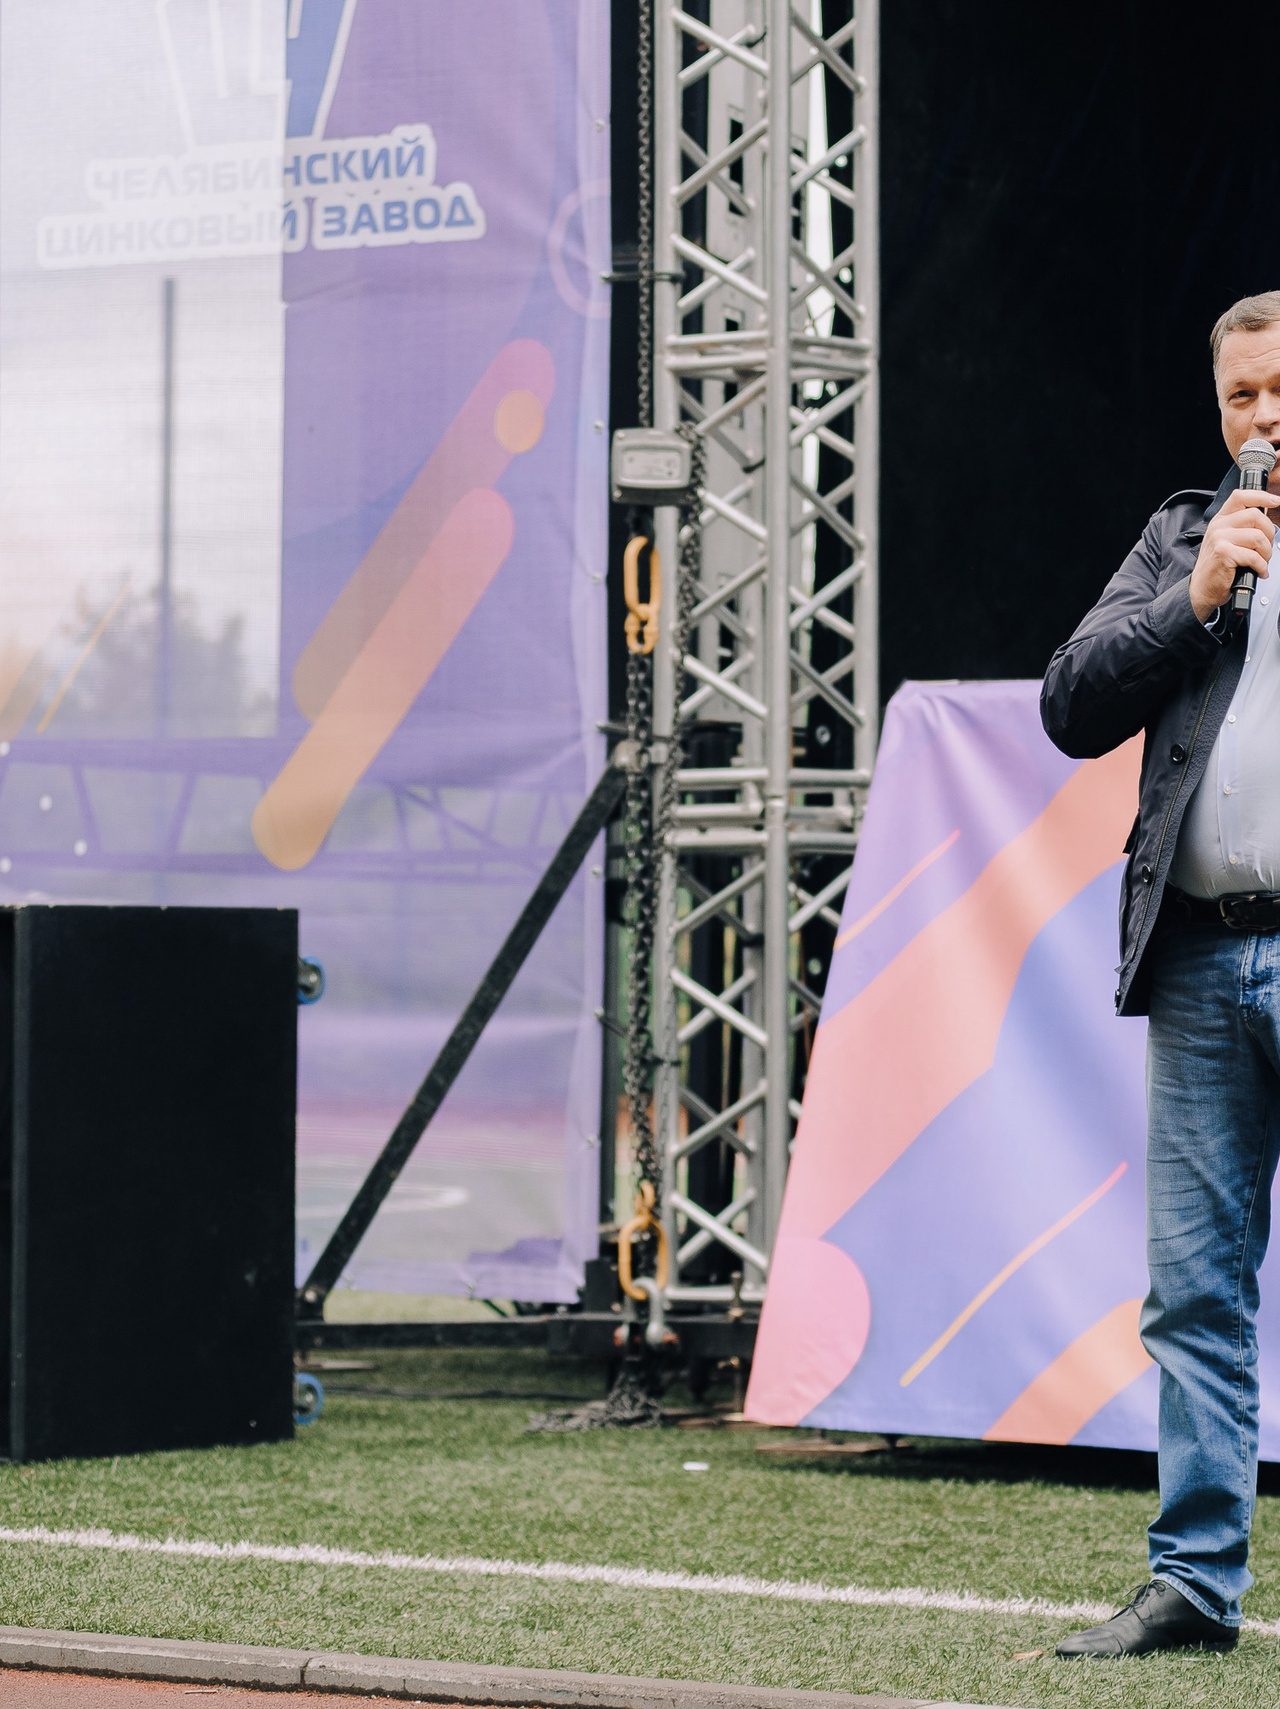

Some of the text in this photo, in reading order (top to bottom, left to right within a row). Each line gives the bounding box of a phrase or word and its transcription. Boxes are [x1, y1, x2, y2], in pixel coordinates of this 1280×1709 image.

[93, 136, 426, 201] ЧЕЛЯБИНСКИЙ
[45, 195, 475, 258] ЦИНКОВЫЙ ЗАВОД
